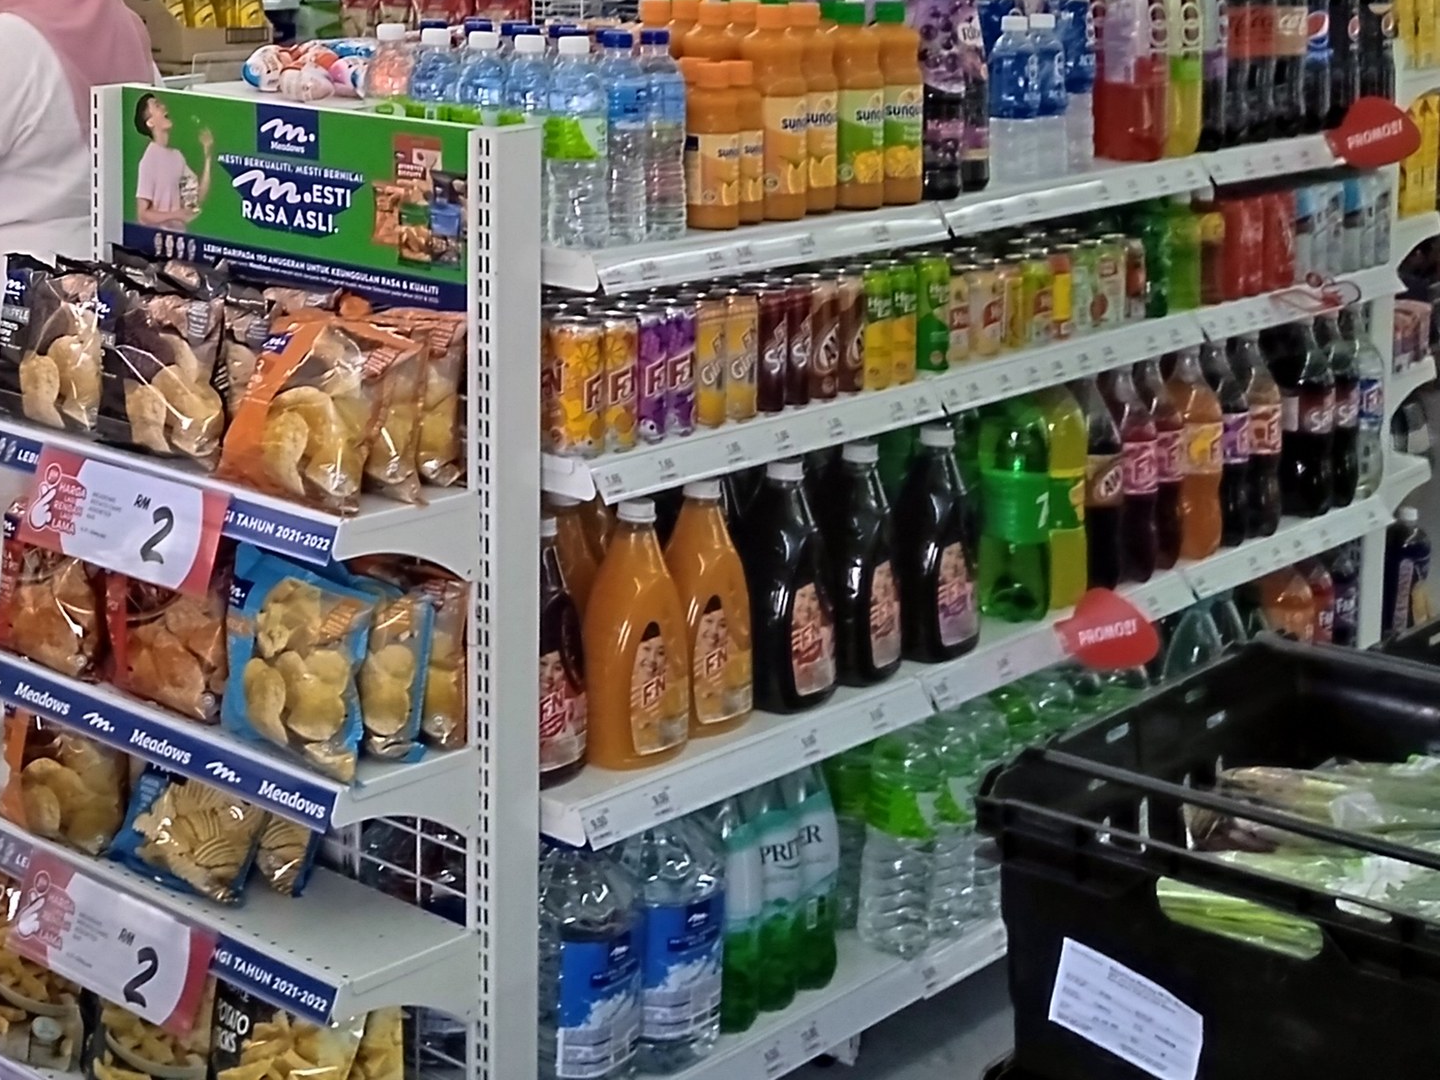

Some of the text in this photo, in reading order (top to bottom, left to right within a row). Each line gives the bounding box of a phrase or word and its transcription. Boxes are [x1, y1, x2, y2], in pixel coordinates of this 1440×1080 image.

[269, 140, 306, 155] Meadows
[1346, 118, 1404, 151] PROMOSI
[217, 154, 243, 166] MESTI
[294, 164, 322, 178] MESTI
[241, 199, 341, 234] RASA ASLI.
[202, 242, 223, 255] LEBIH
[222, 245, 256, 263] DARIPADA
[268, 254, 306, 271] ANUGERAH
[306, 261, 330, 275] UNTUK
[330, 265, 380, 285] KEUNGGULAN
[380, 274, 402, 289] RASA
[408, 280, 440, 296] KUALITI
[59, 480, 87, 500] HARGA
[50, 517, 76, 536] LAMA
[133, 493, 175, 565] RM 2
[235, 512, 332, 553] TAHUN 2021-2022
[1077, 618, 1138, 647] PROMOSI
[14, 681, 72, 716] Meadows
[128, 727, 193, 765] Meadows
[257, 779, 327, 820] Meadows
[117, 927, 159, 1009] RM 2
[233, 957, 329, 1013] TAHUN 2021-2022
